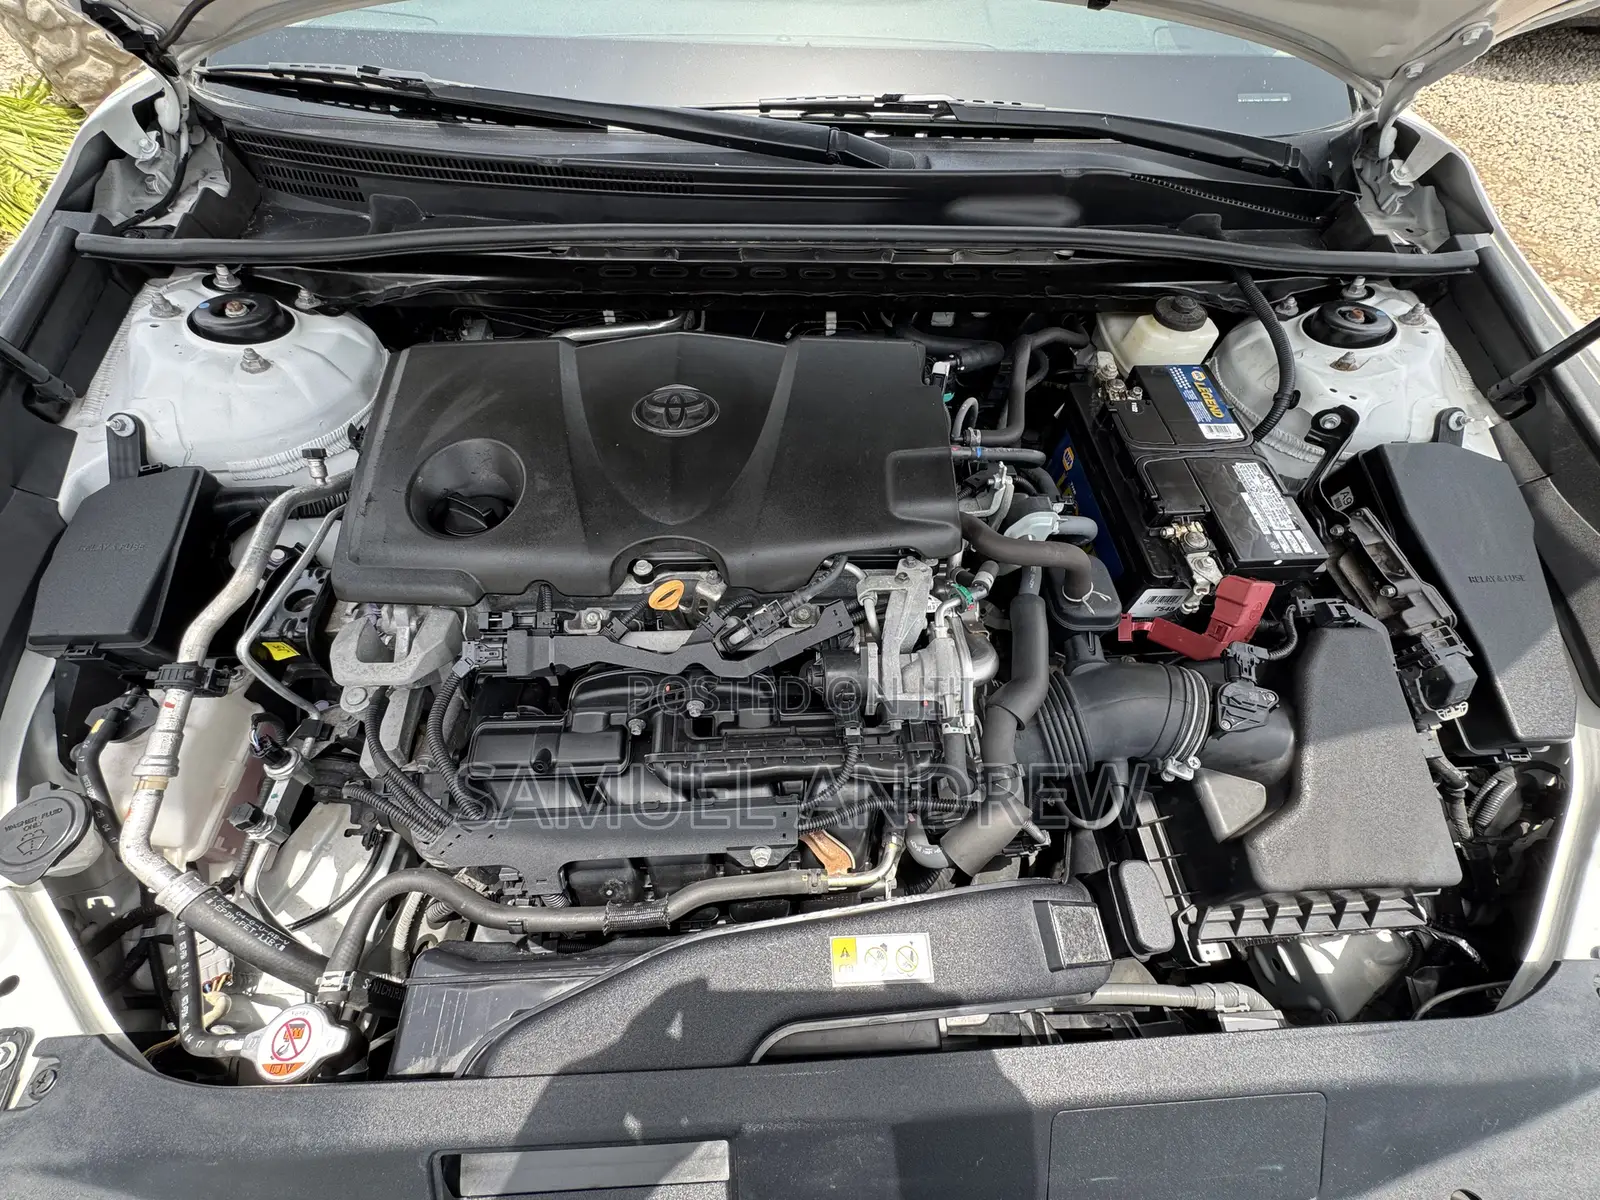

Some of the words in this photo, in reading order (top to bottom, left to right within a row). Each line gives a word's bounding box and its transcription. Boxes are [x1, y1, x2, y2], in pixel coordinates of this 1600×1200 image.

[1193, 381, 1225, 418] LEGEND
[1468, 575, 1496, 584] RELAY
[1504, 574, 1527, 583] FUSE
